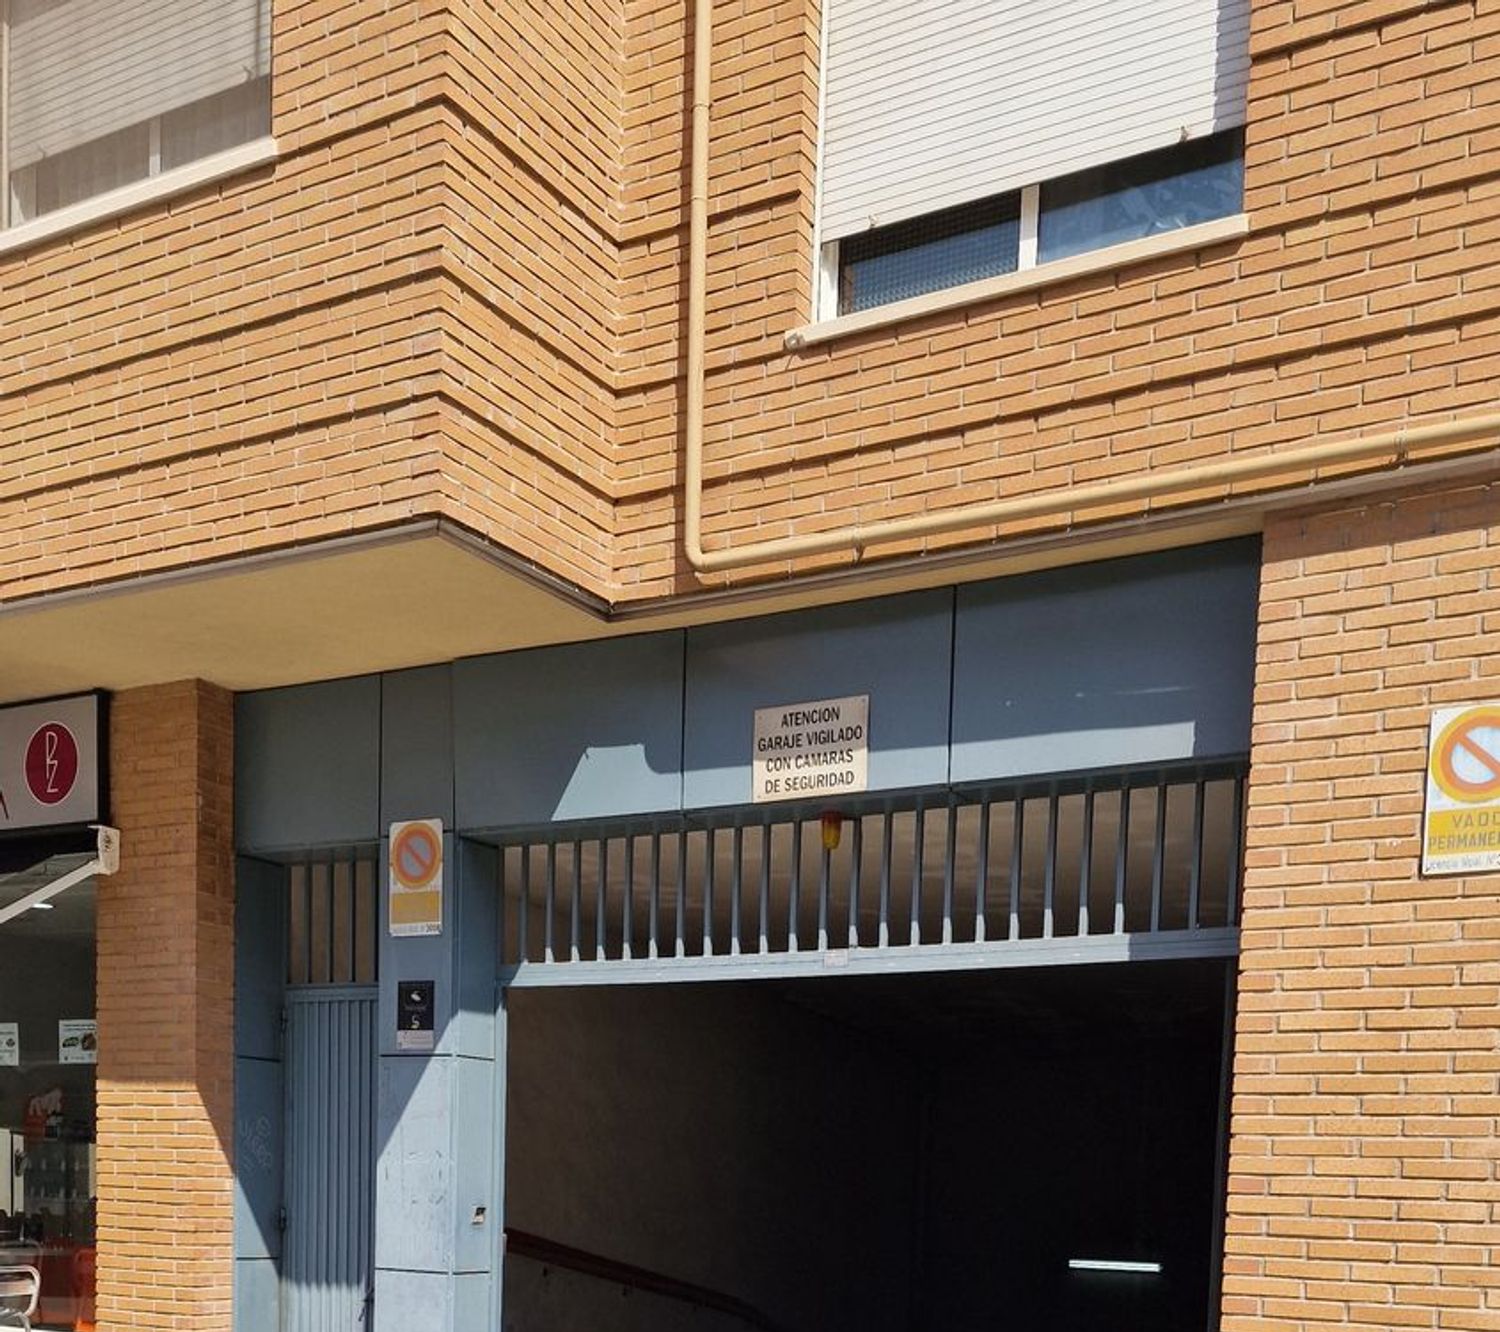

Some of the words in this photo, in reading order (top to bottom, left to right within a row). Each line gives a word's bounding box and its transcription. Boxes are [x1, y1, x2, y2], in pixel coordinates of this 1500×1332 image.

[781, 706, 840, 728] ATENCION
[758, 733, 803, 752] GARAJE
[806, 725, 863, 746] VIGILADO
[766, 756, 791, 773] CON
[795, 748, 854, 770] CAMARAS
[765, 779, 781, 794] DE
[784, 770, 855, 792] SEGURIDAD
